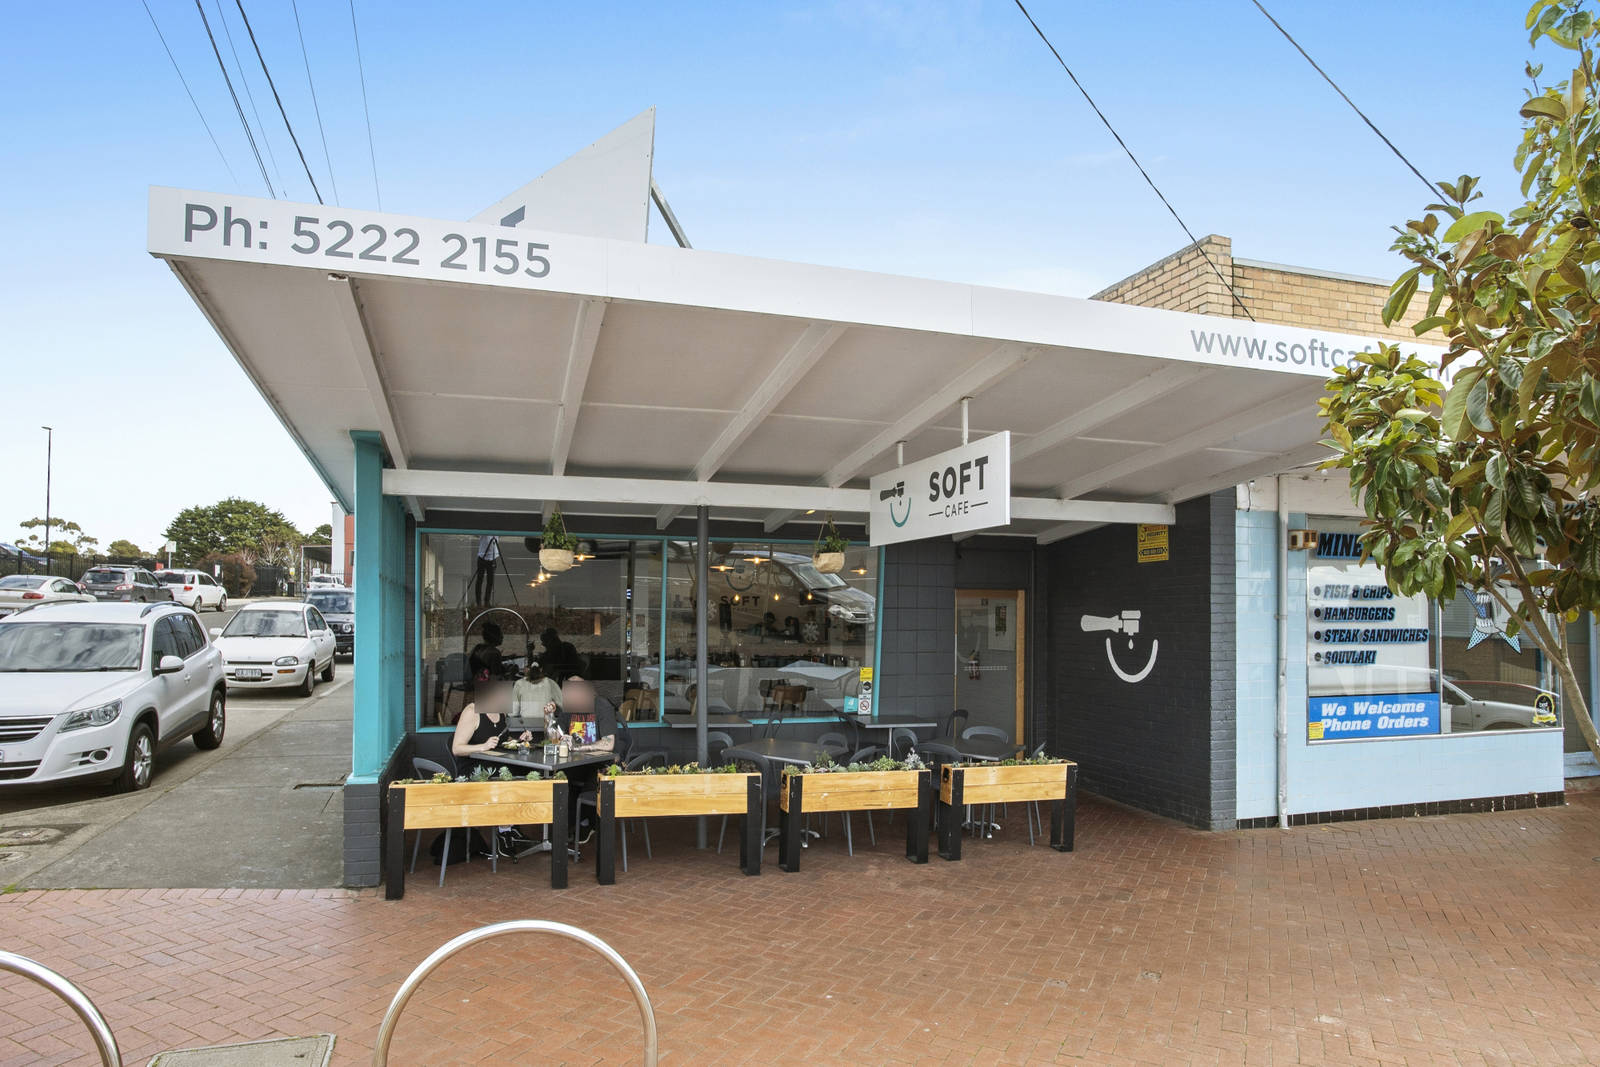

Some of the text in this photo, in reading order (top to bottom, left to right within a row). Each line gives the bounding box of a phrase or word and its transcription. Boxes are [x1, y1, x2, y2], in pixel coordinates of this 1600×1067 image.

[185, 203, 551, 278] Ph: 5222 2155
[929, 455, 989, 502] SOFT
[945, 501, 969, 518] CAFE
[1318, 533, 1372, 558] MINE
[1324, 584, 1394, 600] FISH & CHIPS
[1324, 606, 1395, 621] HAMBURGERS
[1324, 628, 1429, 643] STEAK SANDWICHES
[1324, 650, 1377, 665] SOUVLAKI
[1321, 701, 1426, 716] We Welcome
[1321, 718, 1372, 732] Phone
[1378, 715, 1429, 729] Orders
